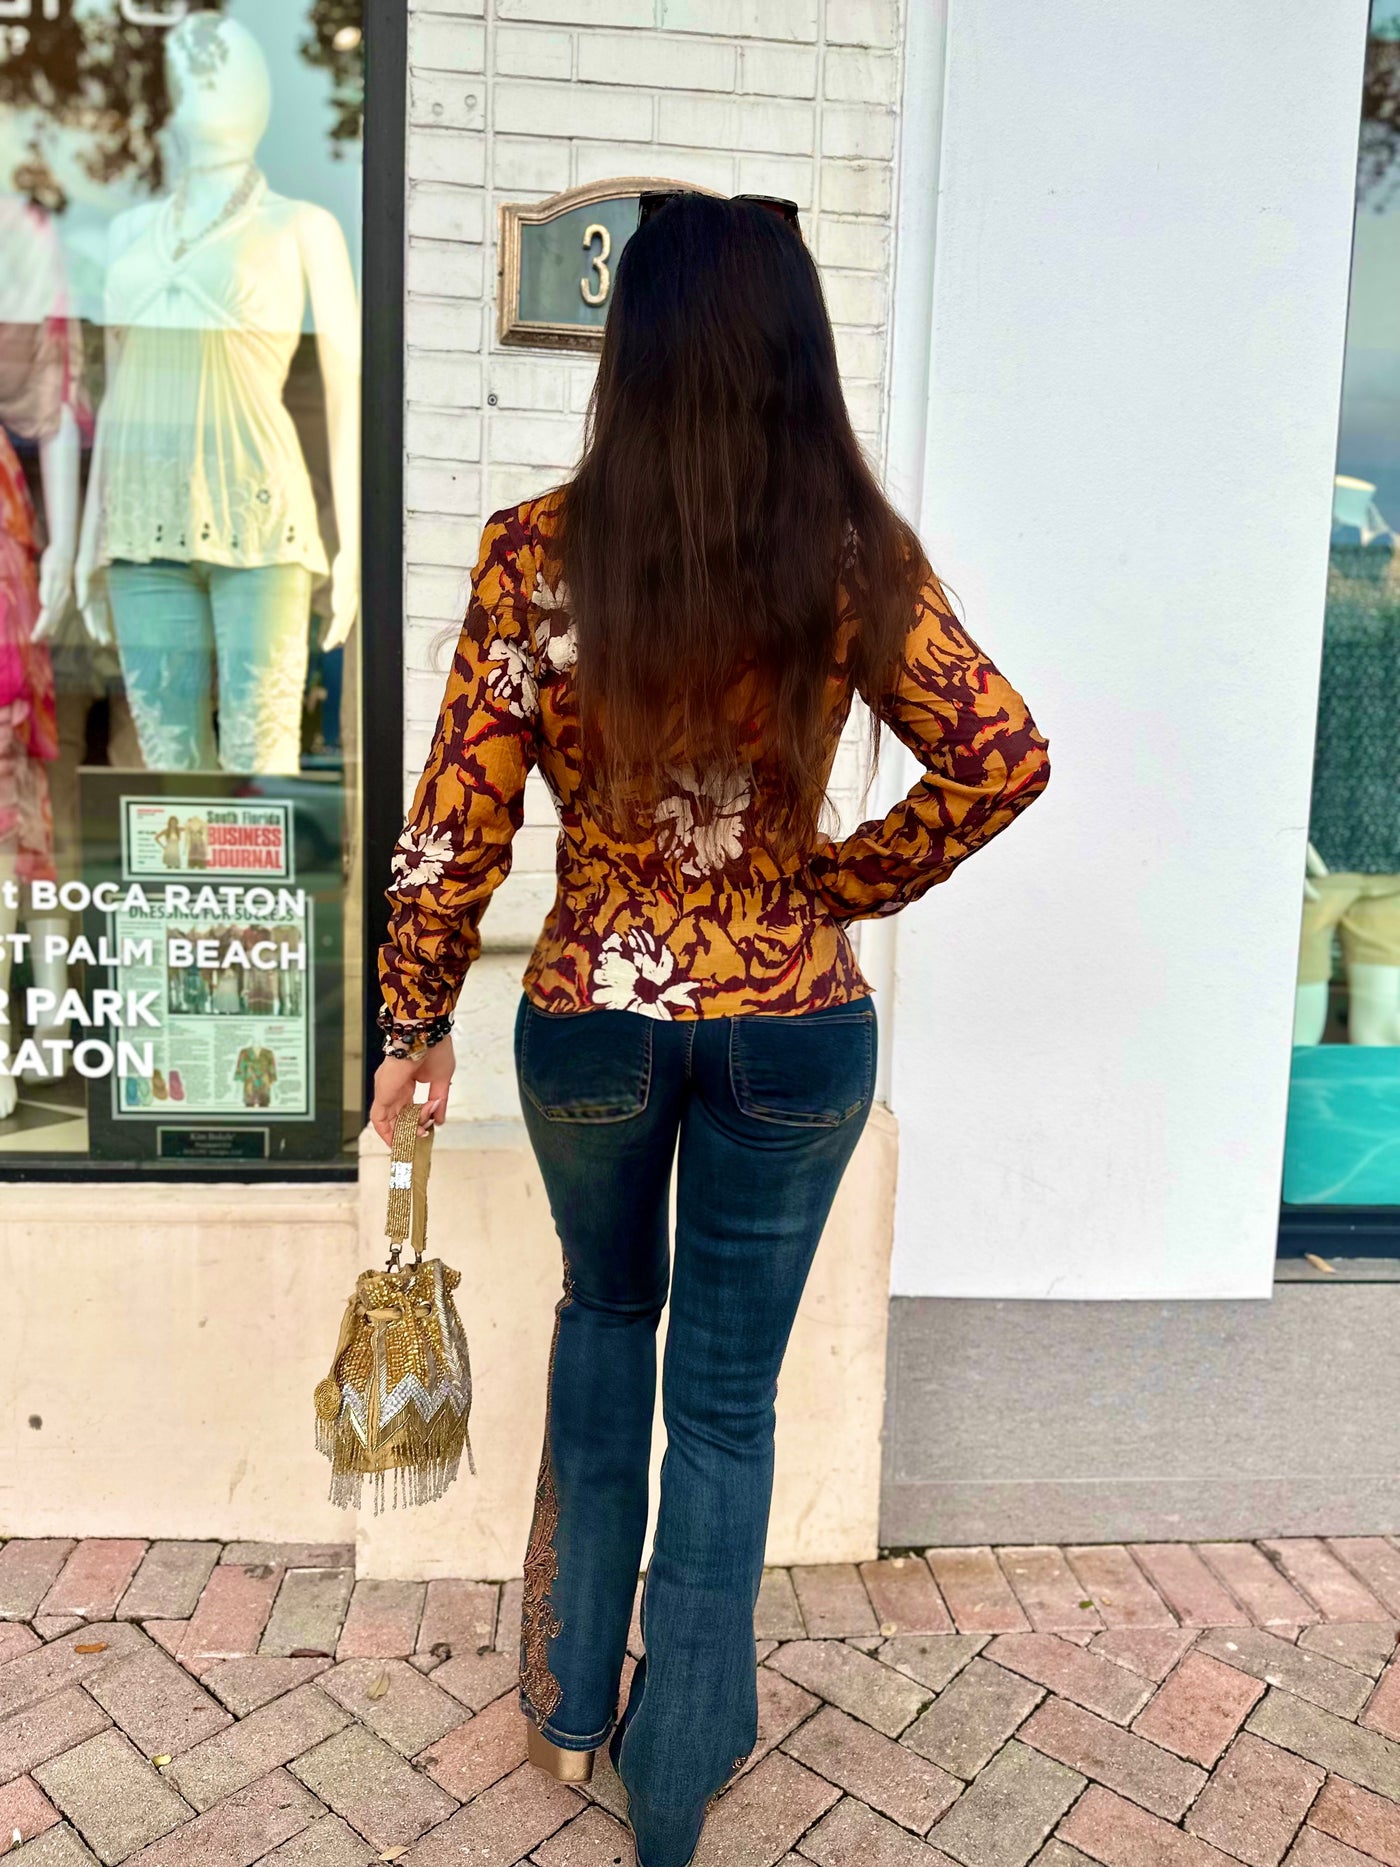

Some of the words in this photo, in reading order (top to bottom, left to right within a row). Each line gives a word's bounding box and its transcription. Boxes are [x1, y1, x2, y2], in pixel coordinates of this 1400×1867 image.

[207, 810, 238, 824] South
[242, 811, 281, 825] Florida
[208, 825, 282, 847] BUSINESS
[207, 848, 282, 869] JOURNAL
[31, 879, 150, 913] BOCA
[164, 884, 306, 918] RATON
[0, 933, 31, 964] T
[44, 934, 154, 966] PALM
[168, 938, 307, 971] BEACH
[26, 987, 162, 1028] PARK
